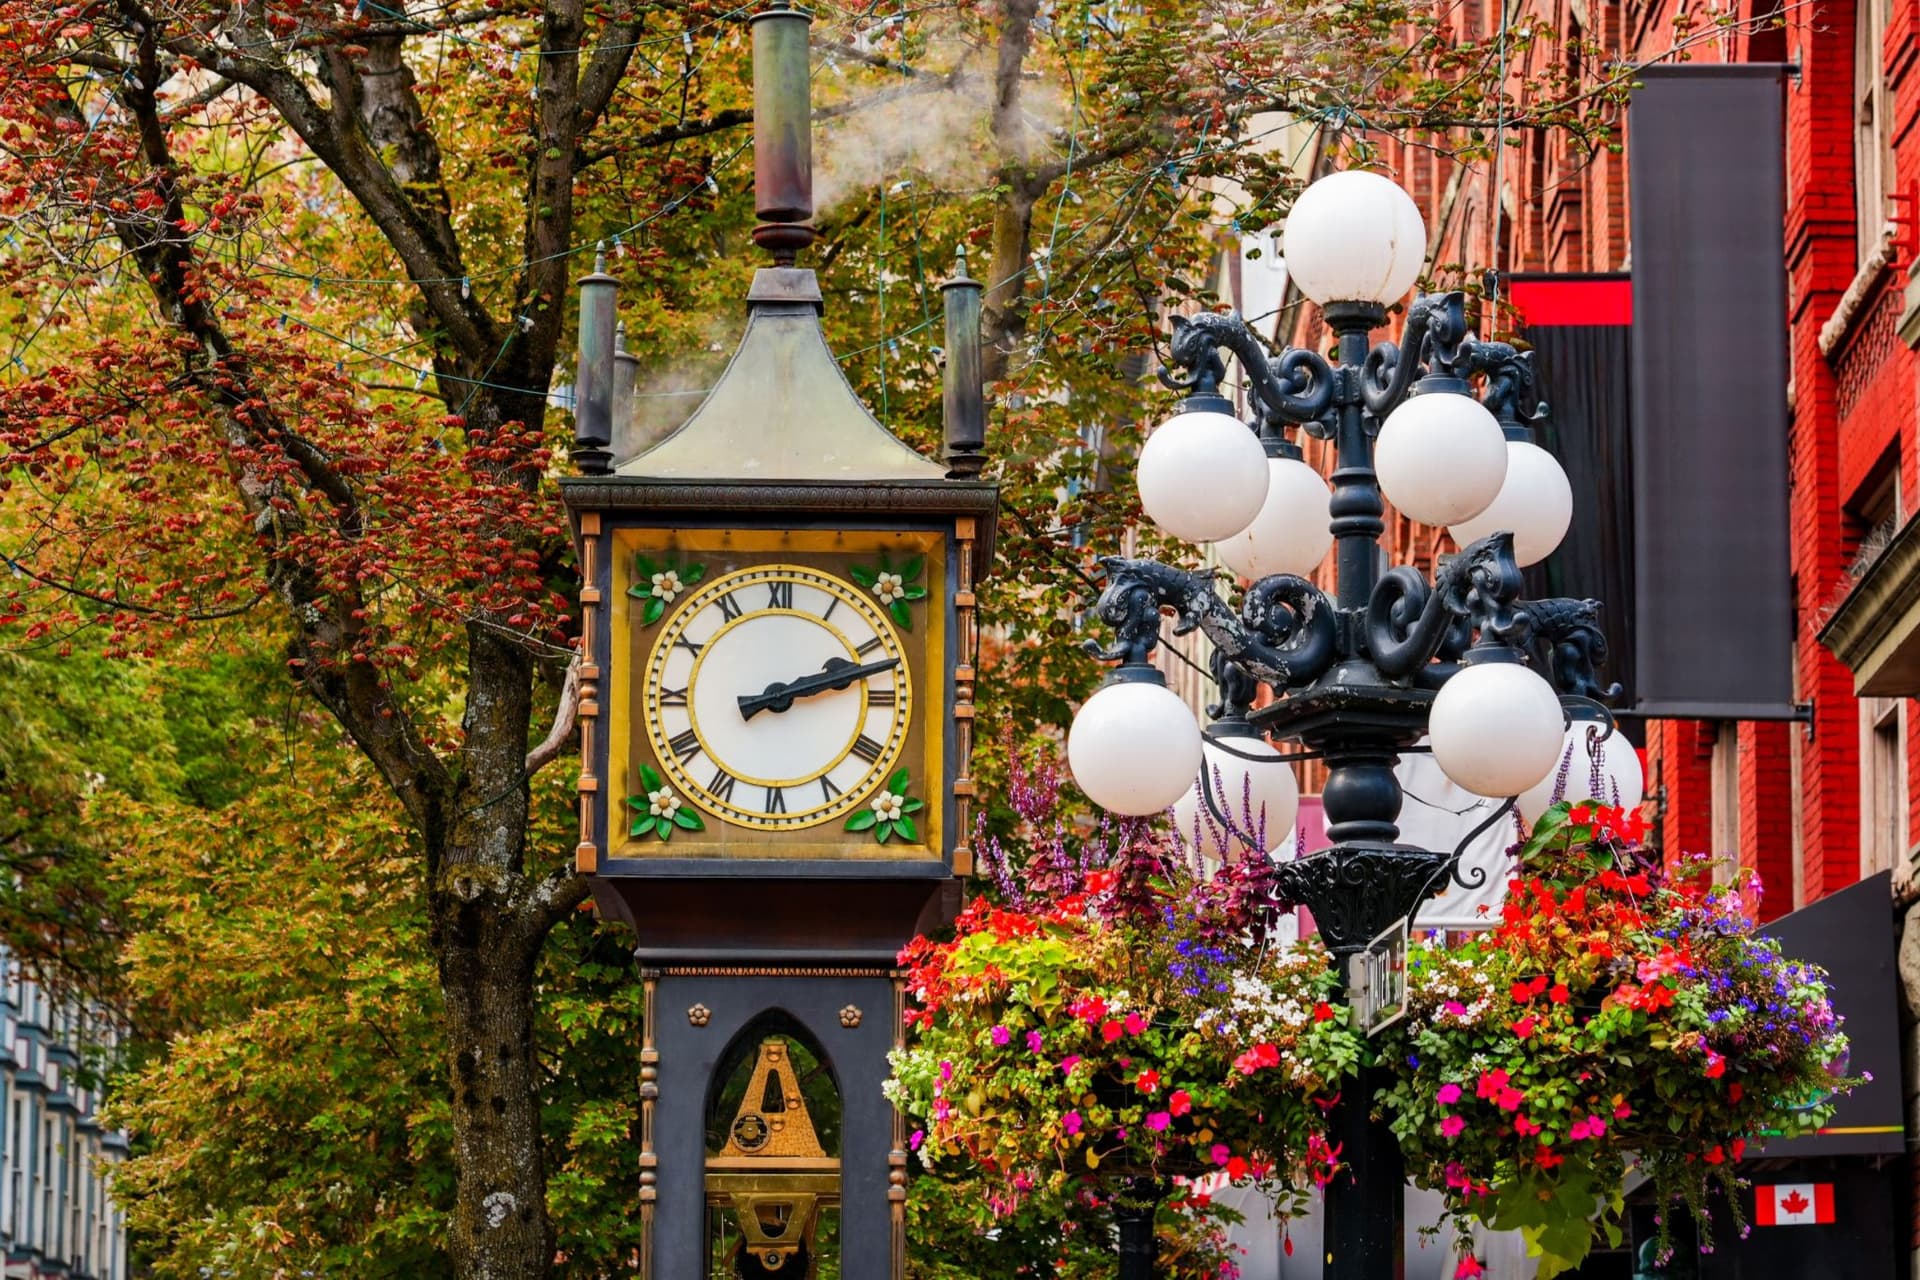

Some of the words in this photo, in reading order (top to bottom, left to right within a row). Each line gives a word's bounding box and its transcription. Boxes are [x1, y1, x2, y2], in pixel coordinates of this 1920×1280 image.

[714, 591, 742, 624] XI
[768, 582, 792, 608] XII
[824, 597, 839, 620] I
[674, 632, 704, 658] X
[856, 637, 882, 656] II
[660, 687, 688, 706] IX
[868, 690, 895, 706] III
[668, 729, 702, 766] VIII
[708, 770, 734, 802] VII
[820, 774, 842, 802] V
[766, 787, 786, 814] VI
